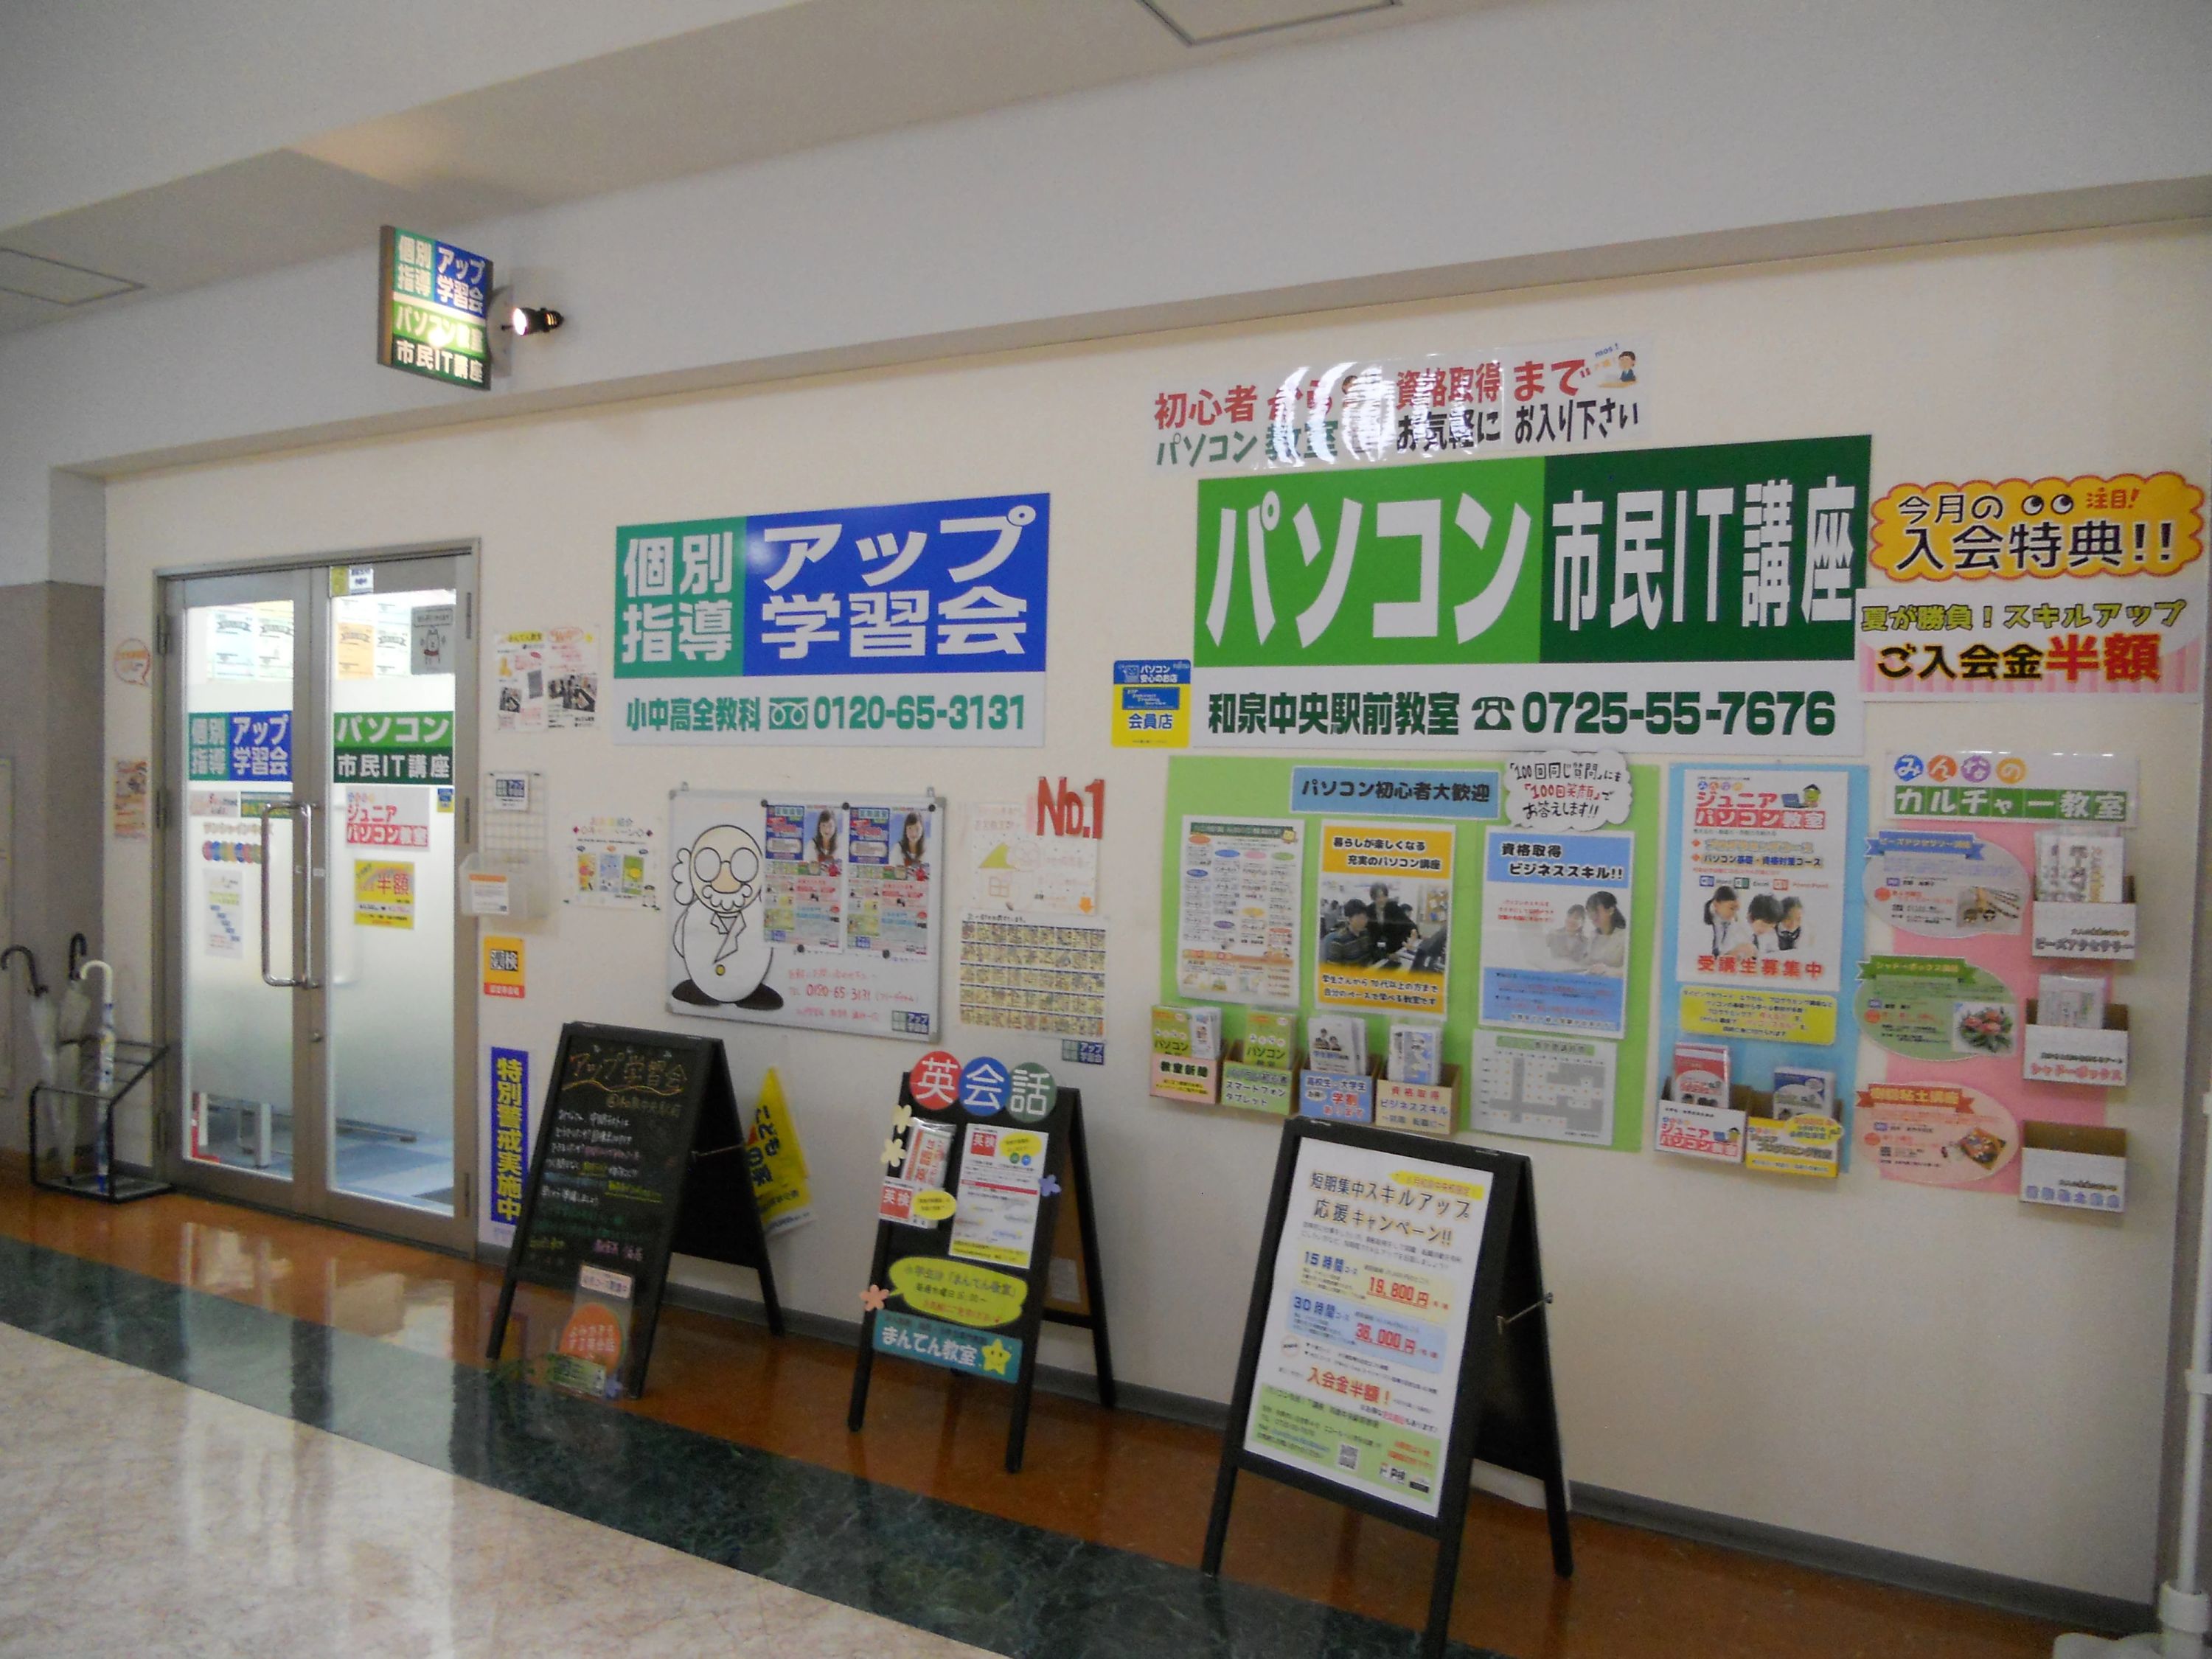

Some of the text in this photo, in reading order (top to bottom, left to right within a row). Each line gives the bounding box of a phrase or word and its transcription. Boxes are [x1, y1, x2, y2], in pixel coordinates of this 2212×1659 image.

[437, 246, 486, 285] アップ
[437, 274, 484, 315] 学習会
[396, 339, 484, 383] 市民IT講座
[1155, 385, 1258, 429] 初心者
[1397, 361, 1501, 410] 資格取得
[1513, 359, 1591, 402] まで
[1156, 432, 1257, 466] パソコン
[1515, 398, 1639, 444] お入り下さい
[1898, 493, 2004, 524] 今月の
[2086, 487, 2140, 510] 注目!
[764, 504, 1036, 591] アップ
[1551, 476, 1855, 631] 市民IT講座
[1896, 521, 2172, 571] 入会特典!!
[623, 532, 734, 598] 個別
[1205, 490, 1532, 649] パソコン
[622, 600, 732, 664] 指導
[762, 585, 1027, 660] 学習会
[1140, 665, 1170, 673] パソコン
[1877, 633, 2163, 682] ご入会金半額
[627, 695, 1024, 732] 小中高全教科 0120-65-3131
[1129, 713, 1173, 729] 会員店
[1208, 690, 1836, 736] 和泉中央駅前教室 0725-55-7676
[232, 713, 289, 746] アップ
[336, 714, 450, 743] パソコン
[232, 746, 288, 776] 学習会
[336, 754, 450, 779] 市民IT講座
[1510, 762, 1621, 782] 「100回同じ質問」にも
[1896, 755, 2023, 783] みんなの
[1301, 779, 1490, 802] パソコン初心者大歓迎
[1524, 784, 1615, 800] 「100回笑顔」で
[1696, 791, 1778, 809] ジュニア
[1896, 788, 2125, 821] カルチャー教室
[348, 803, 397, 823] ジュニア
[1036, 776, 1105, 839] No.1
[1523, 801, 1599, 819] お答えします!!
[1696, 810, 1824, 830] パソコン教室
[1333, 837, 1426, 851] 暮らしが楽しくなる
[1502, 843, 1562, 858] 資格取得
[1348, 855, 1441, 870] 充実のパソコン講座
[1510, 863, 1623, 880] ビジネススキル!!
[1697, 955, 1823, 980] 受講生募集中
[1154, 1040, 1189, 1052] パソコン
[1247, 1046, 1286, 1060] パソコン
[916, 1057, 1051, 1116] 英会話
[1226, 1081, 1287, 1097] スマートフォン
[1226, 1093, 1268, 1105] タブレット
[1391, 1086, 1440, 1100] 資格取得
[1380, 1099, 1448, 1116] ビジネススキル
[973, 1133, 997, 1148] 英検
[1661, 1123, 1710, 1138] ジュニア
[883, 1186, 911, 1207] 英検
[1310, 1172, 1470, 1219] 短期集中スキルアップ
[1314, 1198, 1453, 1245] 応援キャンペーン!!
[881, 1326, 978, 1366] まんてん教室
[1307, 1366, 1391, 1405] 入会金半額!
